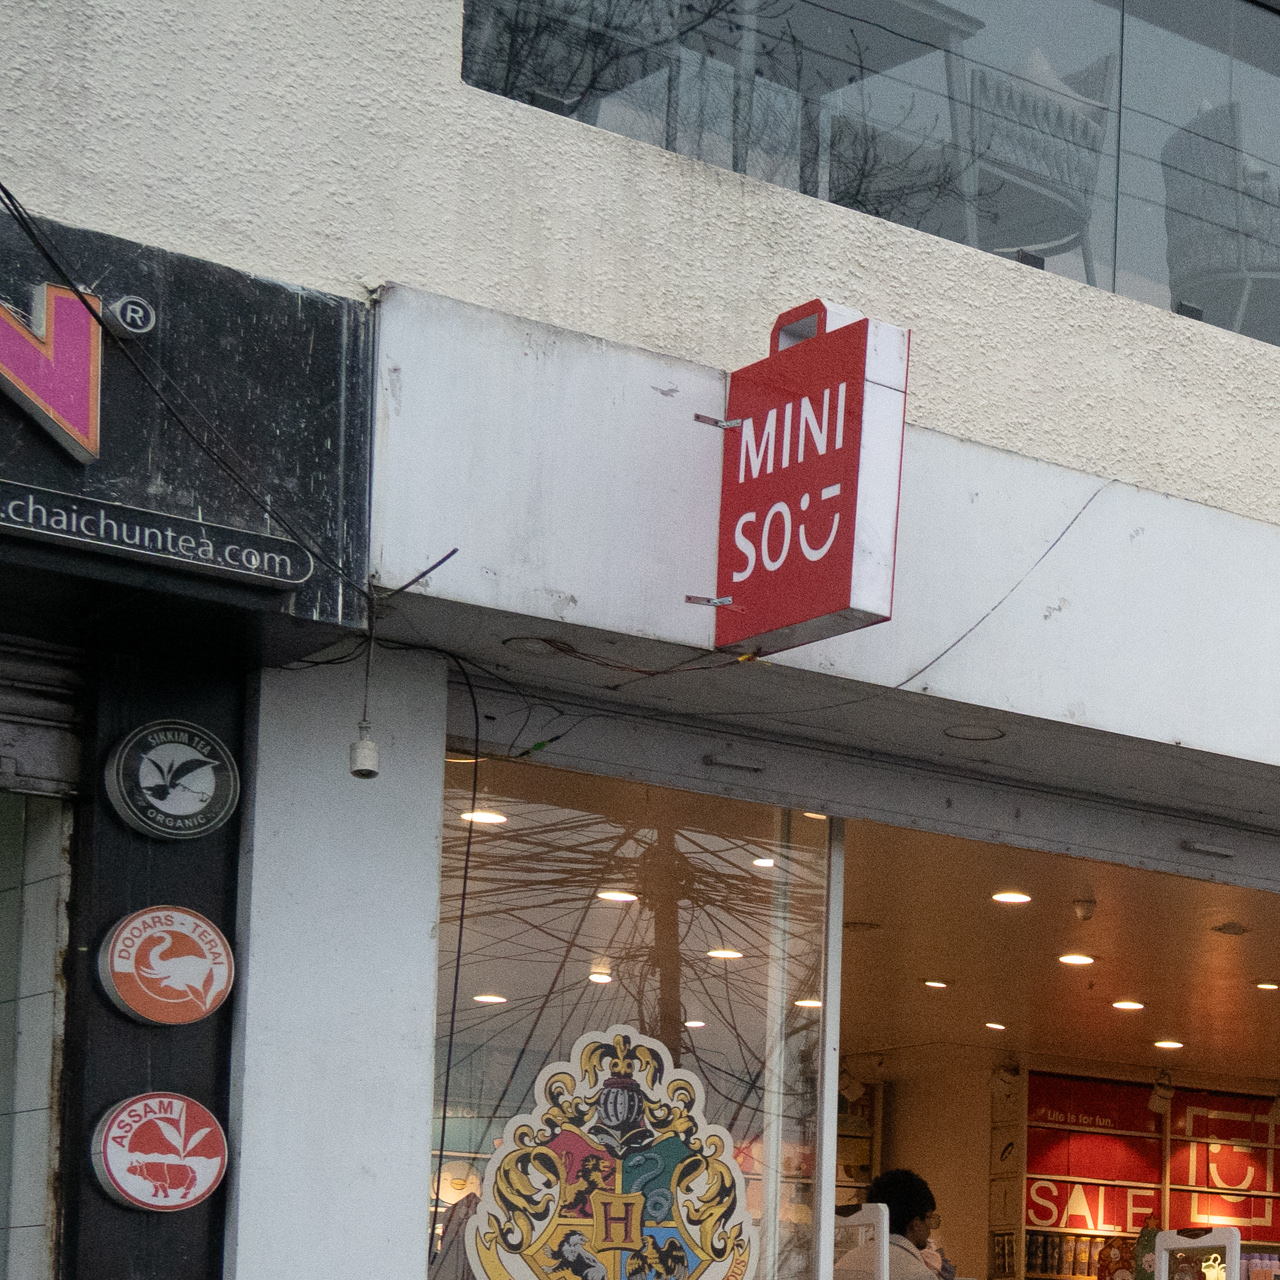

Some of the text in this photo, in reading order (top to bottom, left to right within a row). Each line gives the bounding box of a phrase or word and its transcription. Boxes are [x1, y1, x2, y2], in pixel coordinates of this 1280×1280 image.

[739, 381, 846, 483] MINI
[150, 730, 211, 755] SIKKIM TEA
[147, 809, 207, 829] ORGANIC
[118, 914, 175, 961] DOOARS
[191, 921, 225, 966] TERAI
[111, 1099, 174, 1149] ASSAM
[1047, 1109, 1065, 1122] Life
[1079, 1113, 1094, 1124] for
[602, 1201, 633, 1244] H
[1027, 1180, 1155, 1233] SALE
